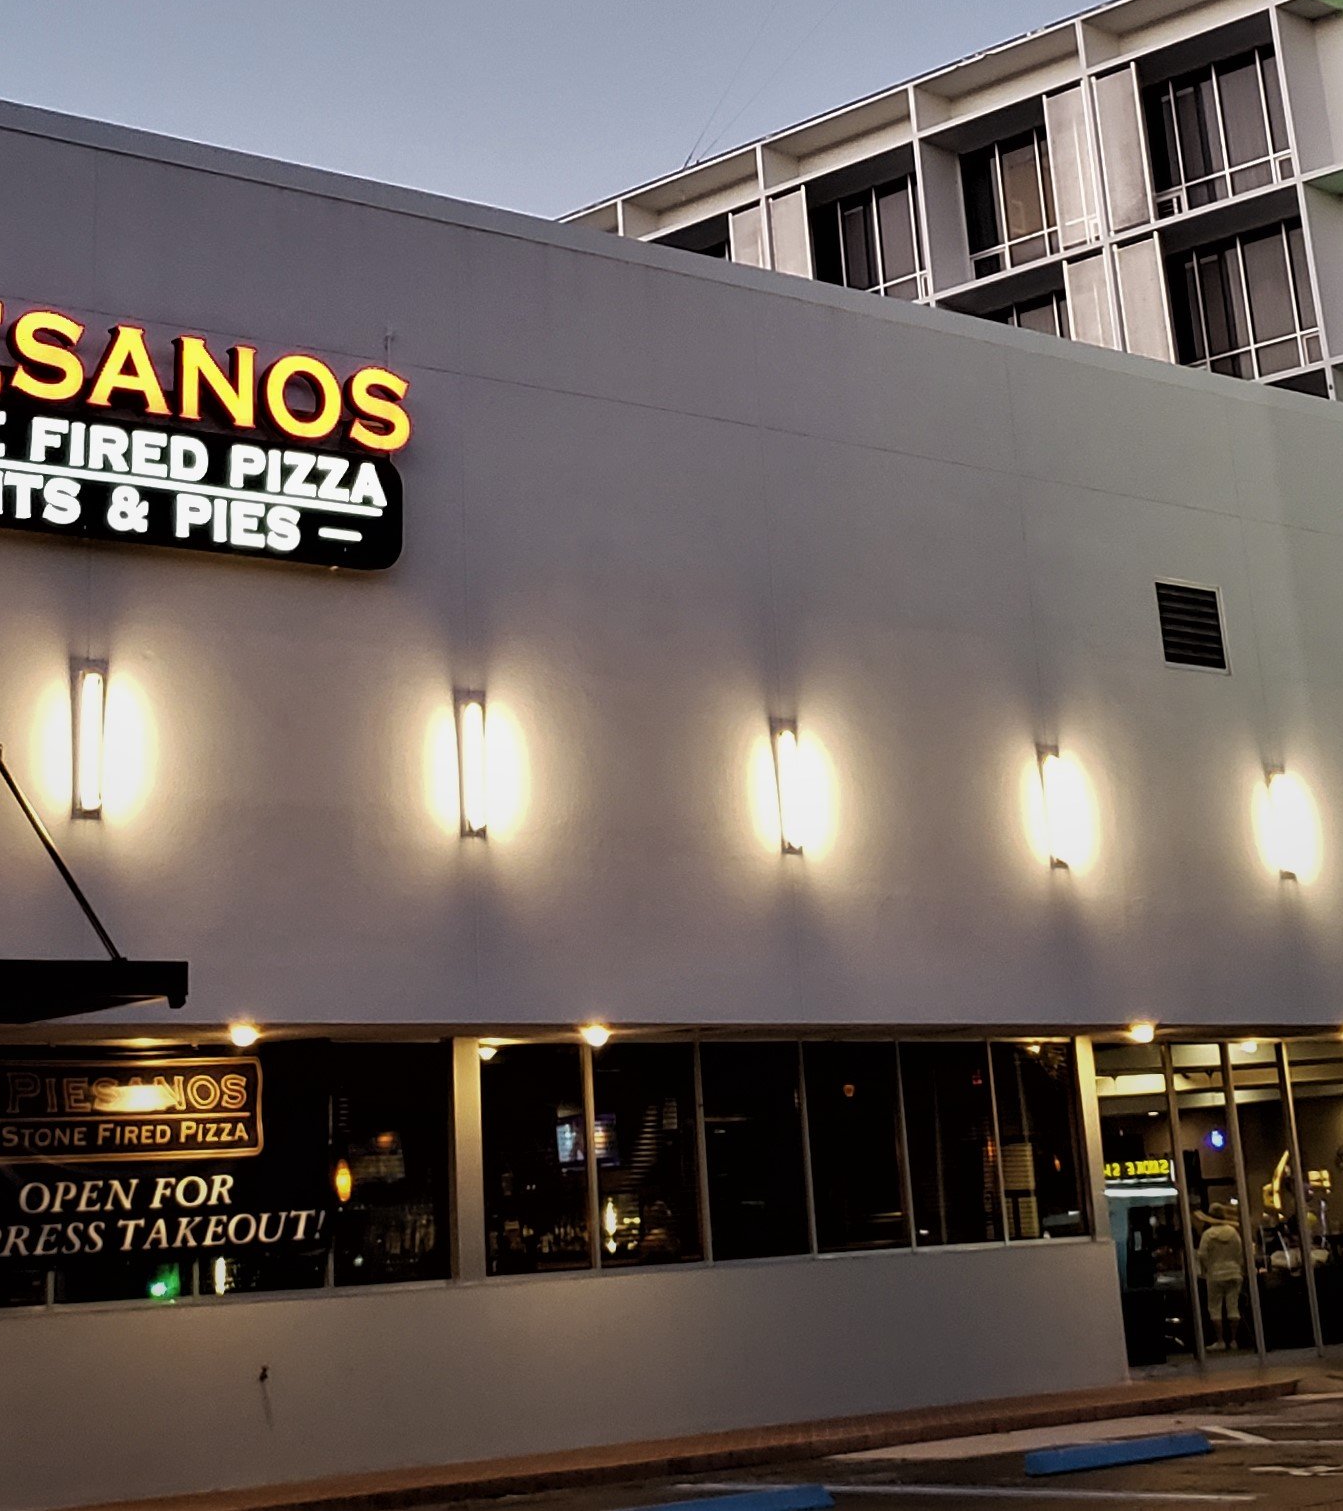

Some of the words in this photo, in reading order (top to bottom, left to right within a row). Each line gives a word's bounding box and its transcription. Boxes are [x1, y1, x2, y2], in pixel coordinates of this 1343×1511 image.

[24, 417, 210, 484] FIRED
[227, 445, 388, 508] PIZZA
[106, 486, 149, 534] &
[173, 495, 301, 553] PIES
[6, 1072, 248, 1114] PIESNOS
[1, 1126, 88, 1148] STONE
[96, 1122, 172, 1146] FIRED
[178, 1120, 249, 1144] PIZZA
[18, 1178, 142, 1214] OPEN
[150, 1174, 235, 1209] FOR
[117, 1209, 327, 1251] TAKEOUT!
